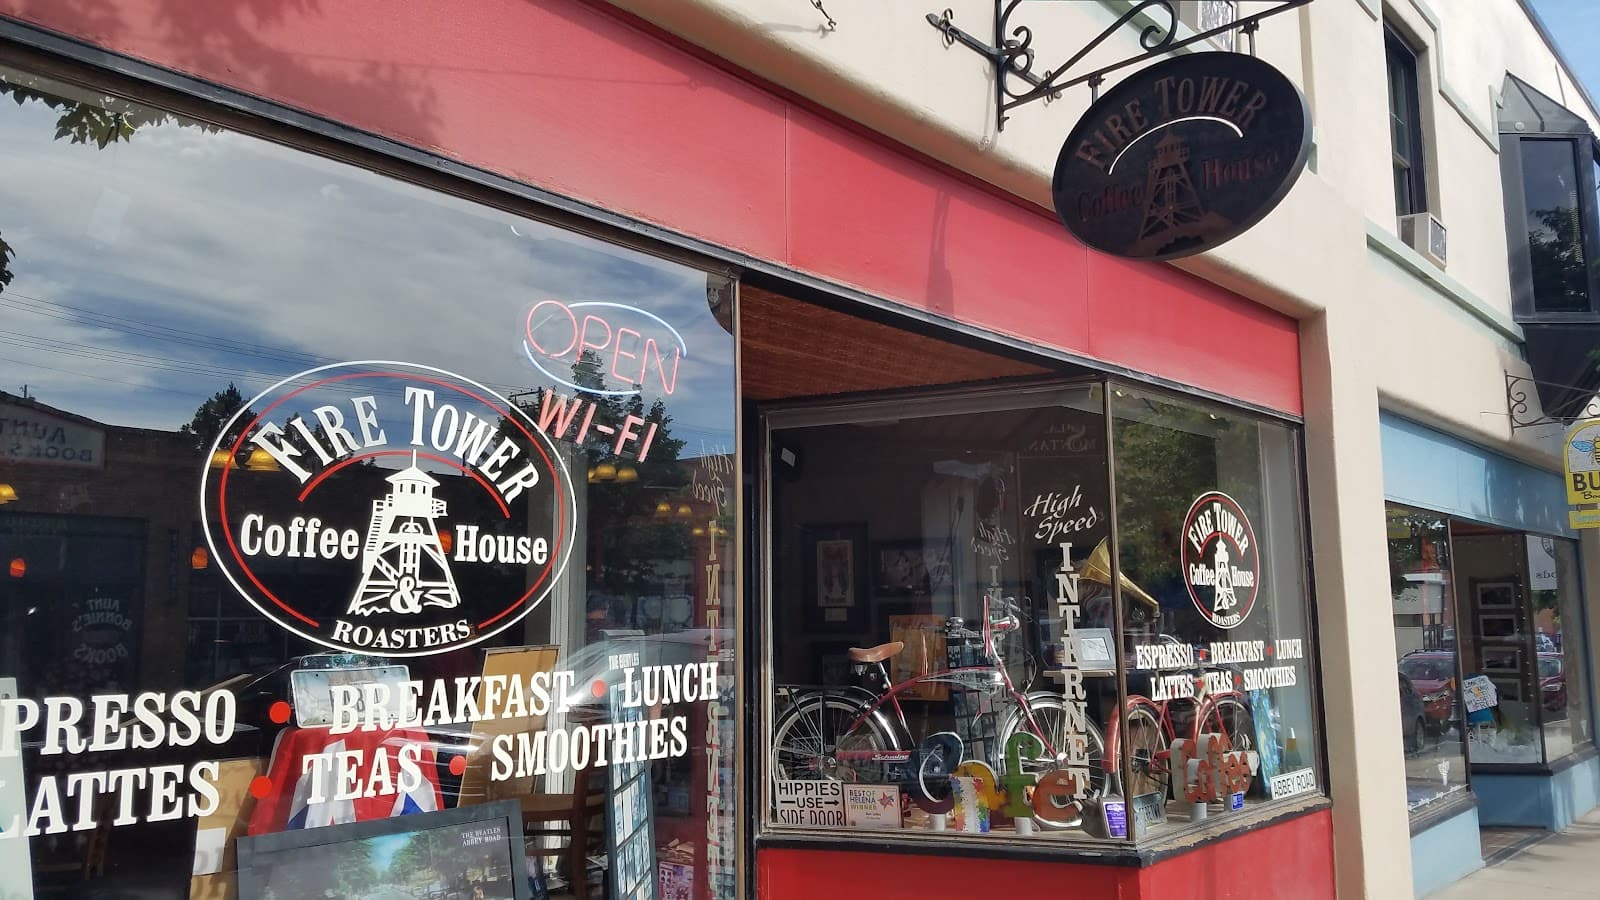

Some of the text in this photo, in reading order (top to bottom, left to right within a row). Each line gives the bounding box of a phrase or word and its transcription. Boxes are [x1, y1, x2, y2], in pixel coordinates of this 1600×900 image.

[1076, 74, 1267, 169] FIRE TOWER
[526, 299, 681, 395] OPEN
[537, 388, 659, 464] WI-FI
[250, 386, 541, 505] FIRE TOWER
[1023, 484, 1082, 519] High
[239, 512, 549, 566] Coffee House
[1034, 505, 1097, 545] Speed
[1187, 502, 1249, 557] FIRE TOWER
[1188, 562, 1254, 588] Coffee House
[330, 618, 472, 651] ROASTERS
[1212, 611, 1241, 626] ROASTERS
[1135, 638, 1303, 670] ESPRESSO BREAKFAST LUNCH
[1150, 666, 1297, 702] LATTES TEAS SMOOTHIES
[0, 661, 720, 757] PRESSO BREAKFAST LUNCH
[302, 743, 422, 805] TEAS
[490, 715, 689, 783] SMOOTHIES
[778, 782, 841, 797] HIPPIES
[796, 797, 824, 809] USE
[1273, 772, 1315, 799] ABBEY ROAD
[462, 831, 474, 840] THE
[780, 809, 805, 826] SIDE
[809, 810, 848, 827] DOOR
[484, 834, 501, 844] ROAD
